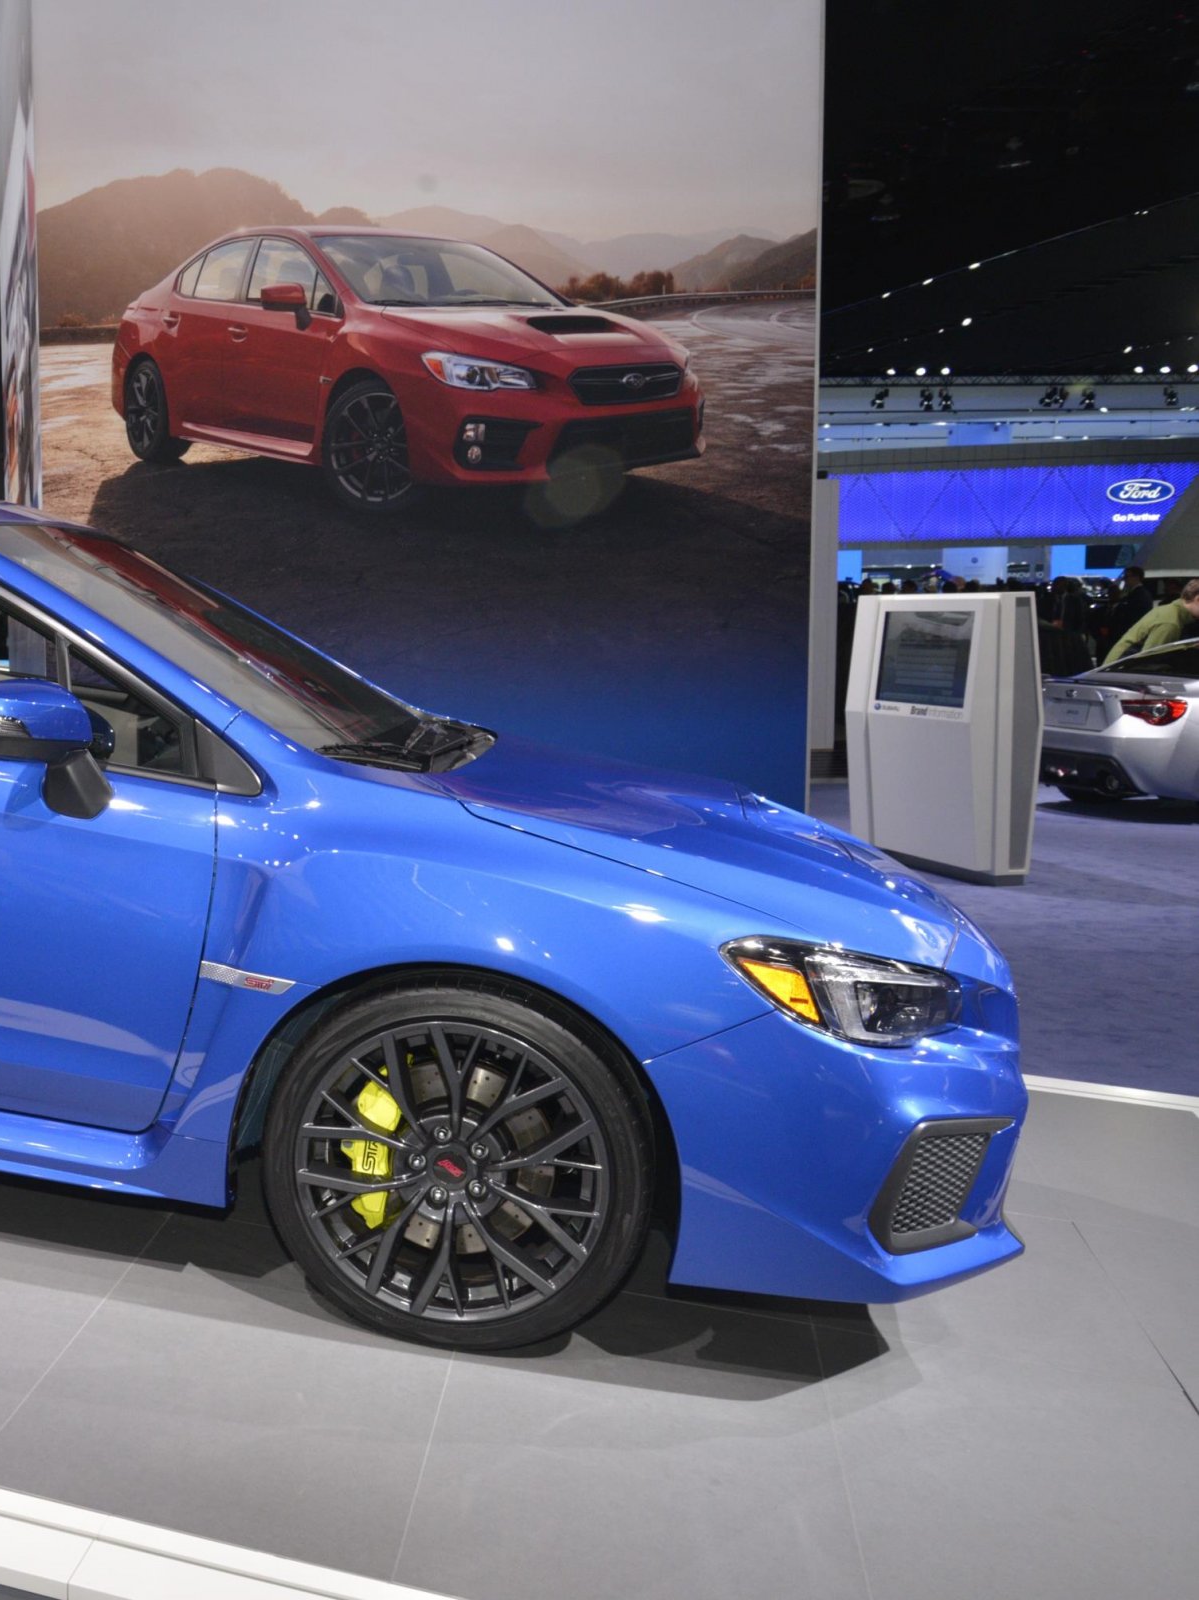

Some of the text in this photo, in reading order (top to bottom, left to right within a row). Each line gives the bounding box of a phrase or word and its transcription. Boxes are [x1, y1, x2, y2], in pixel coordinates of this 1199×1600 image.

[1119, 483, 1162, 499] Ford
[1112, 513, 1161, 522] Go Further
[910, 705, 928, 716] Brand
